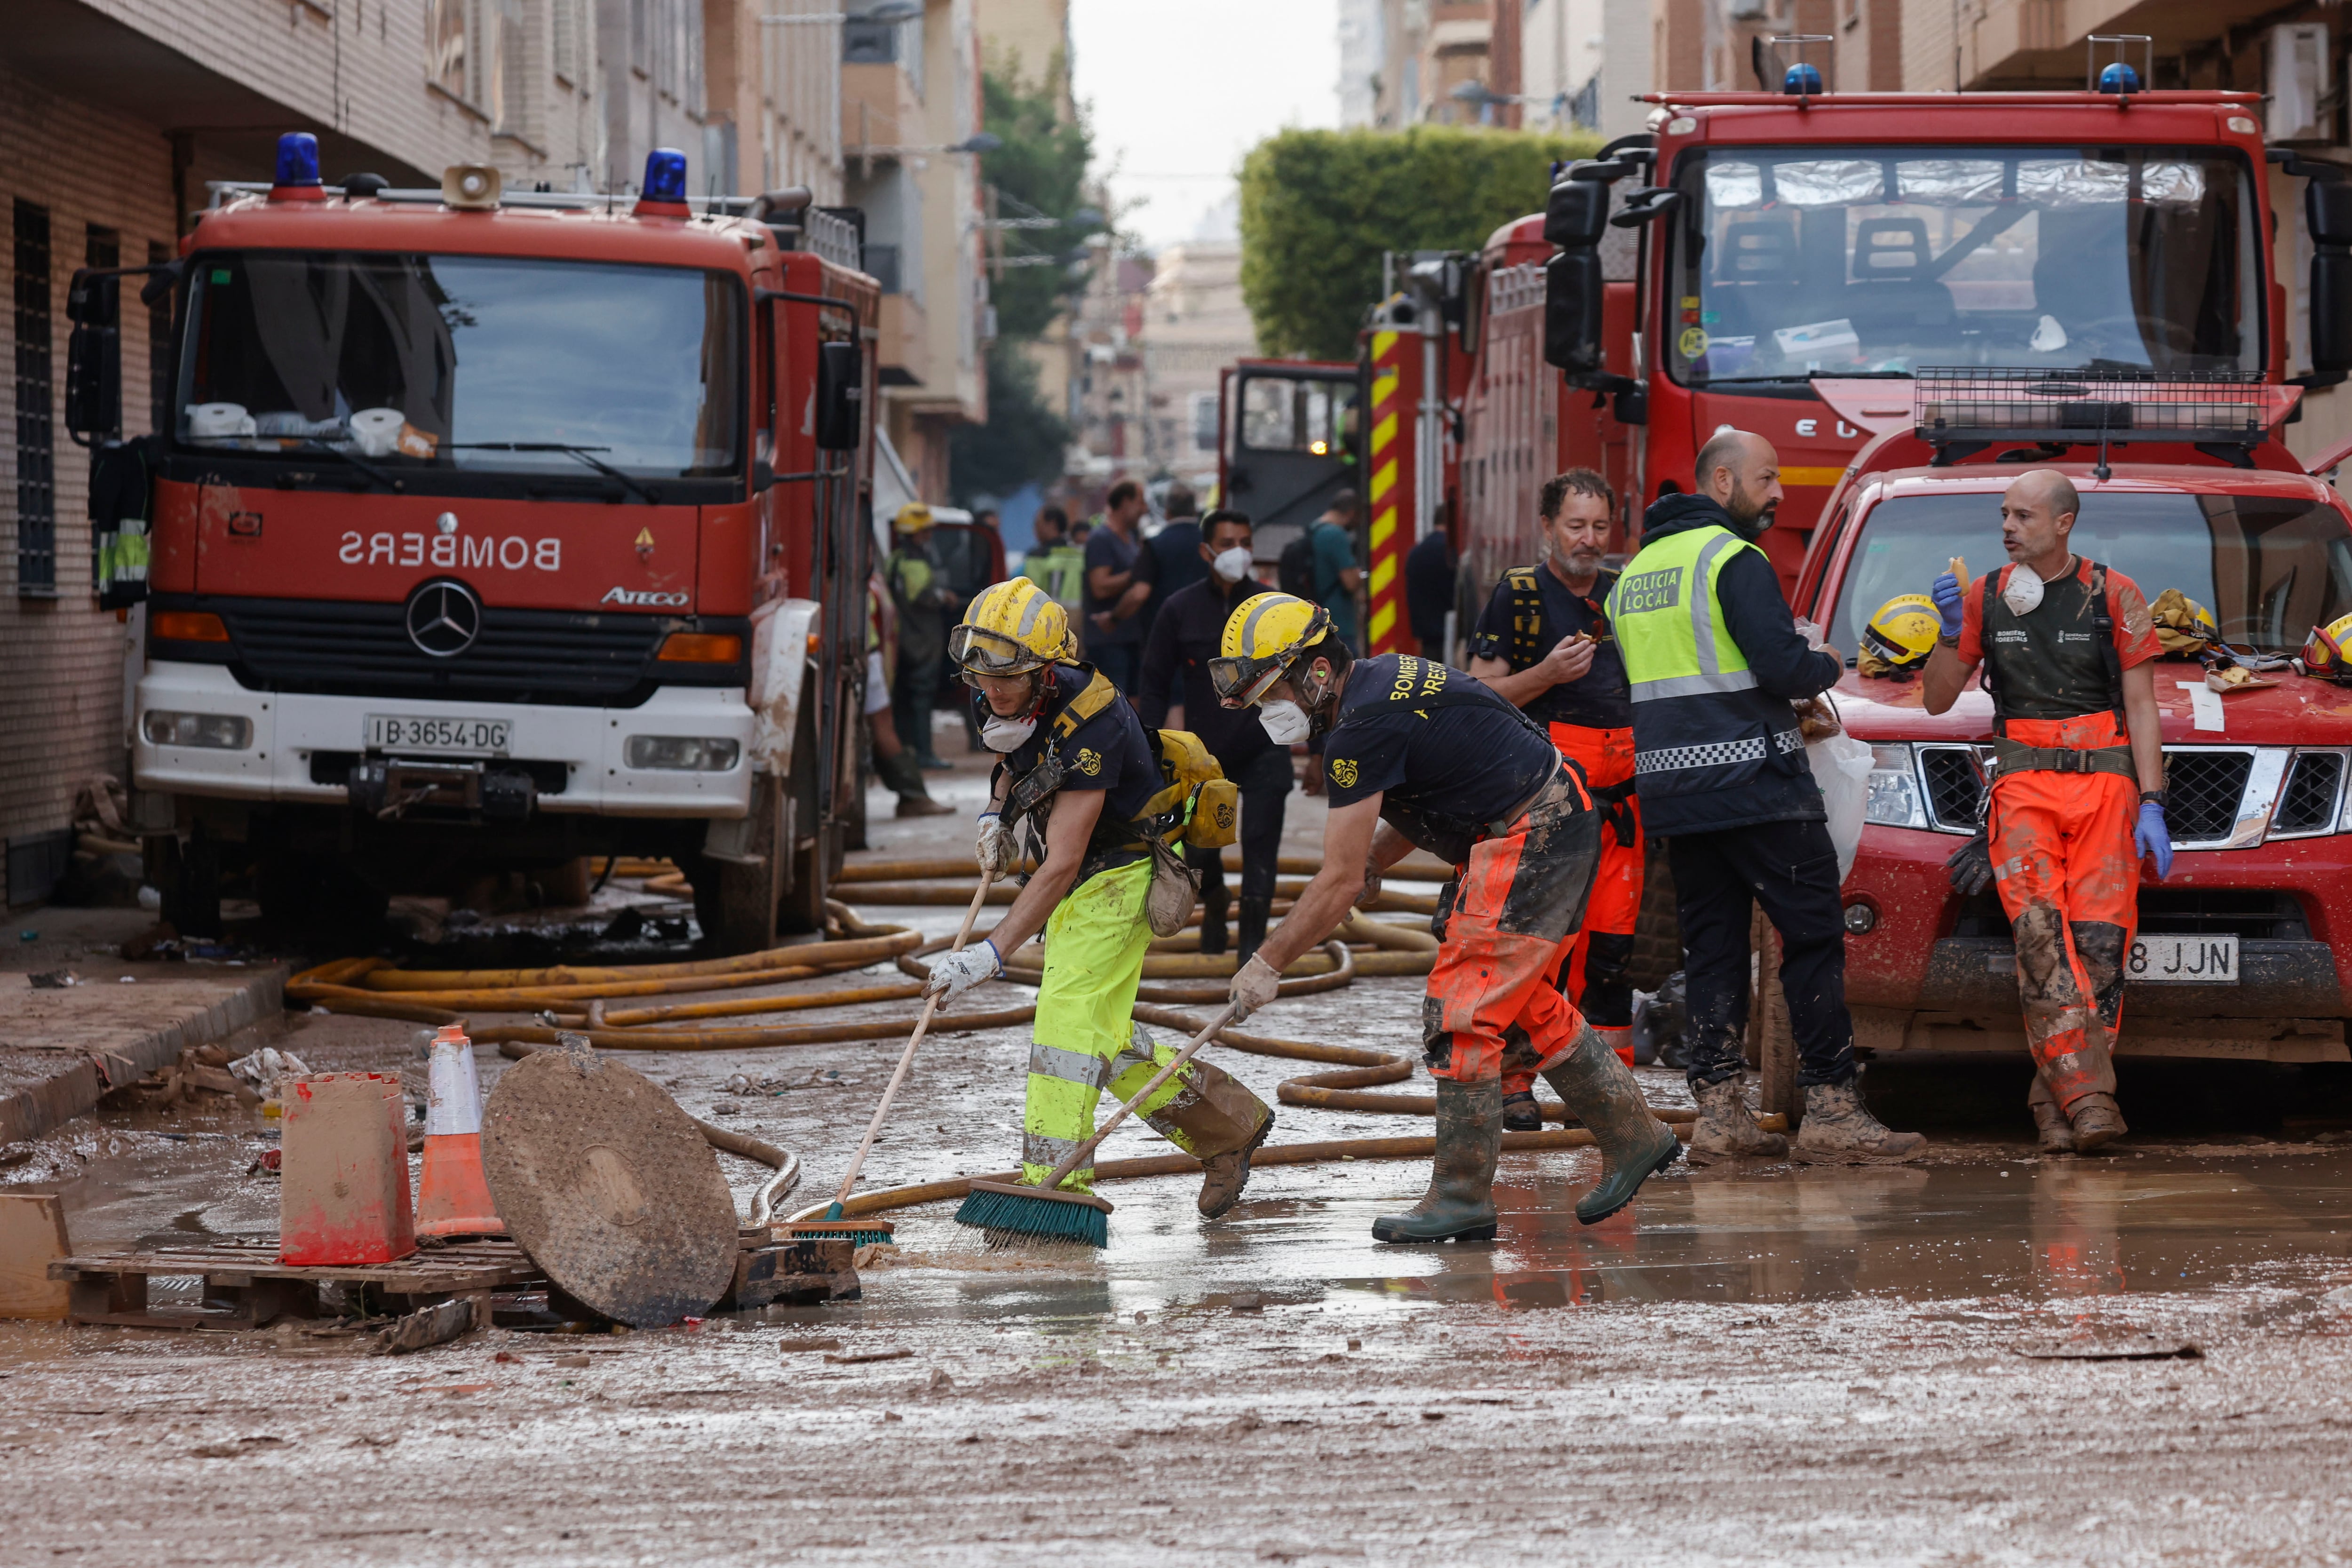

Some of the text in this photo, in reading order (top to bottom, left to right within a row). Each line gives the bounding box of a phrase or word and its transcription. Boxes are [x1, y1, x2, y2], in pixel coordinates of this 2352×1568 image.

[1795, 418, 1858, 439] EU
[1623, 571, 1677, 594] POLICIA
[1625, 589, 1669, 611] LOCAL
[1389, 654, 1419, 700] BOMBER
[2129, 942, 2229, 974] 8 JJN
